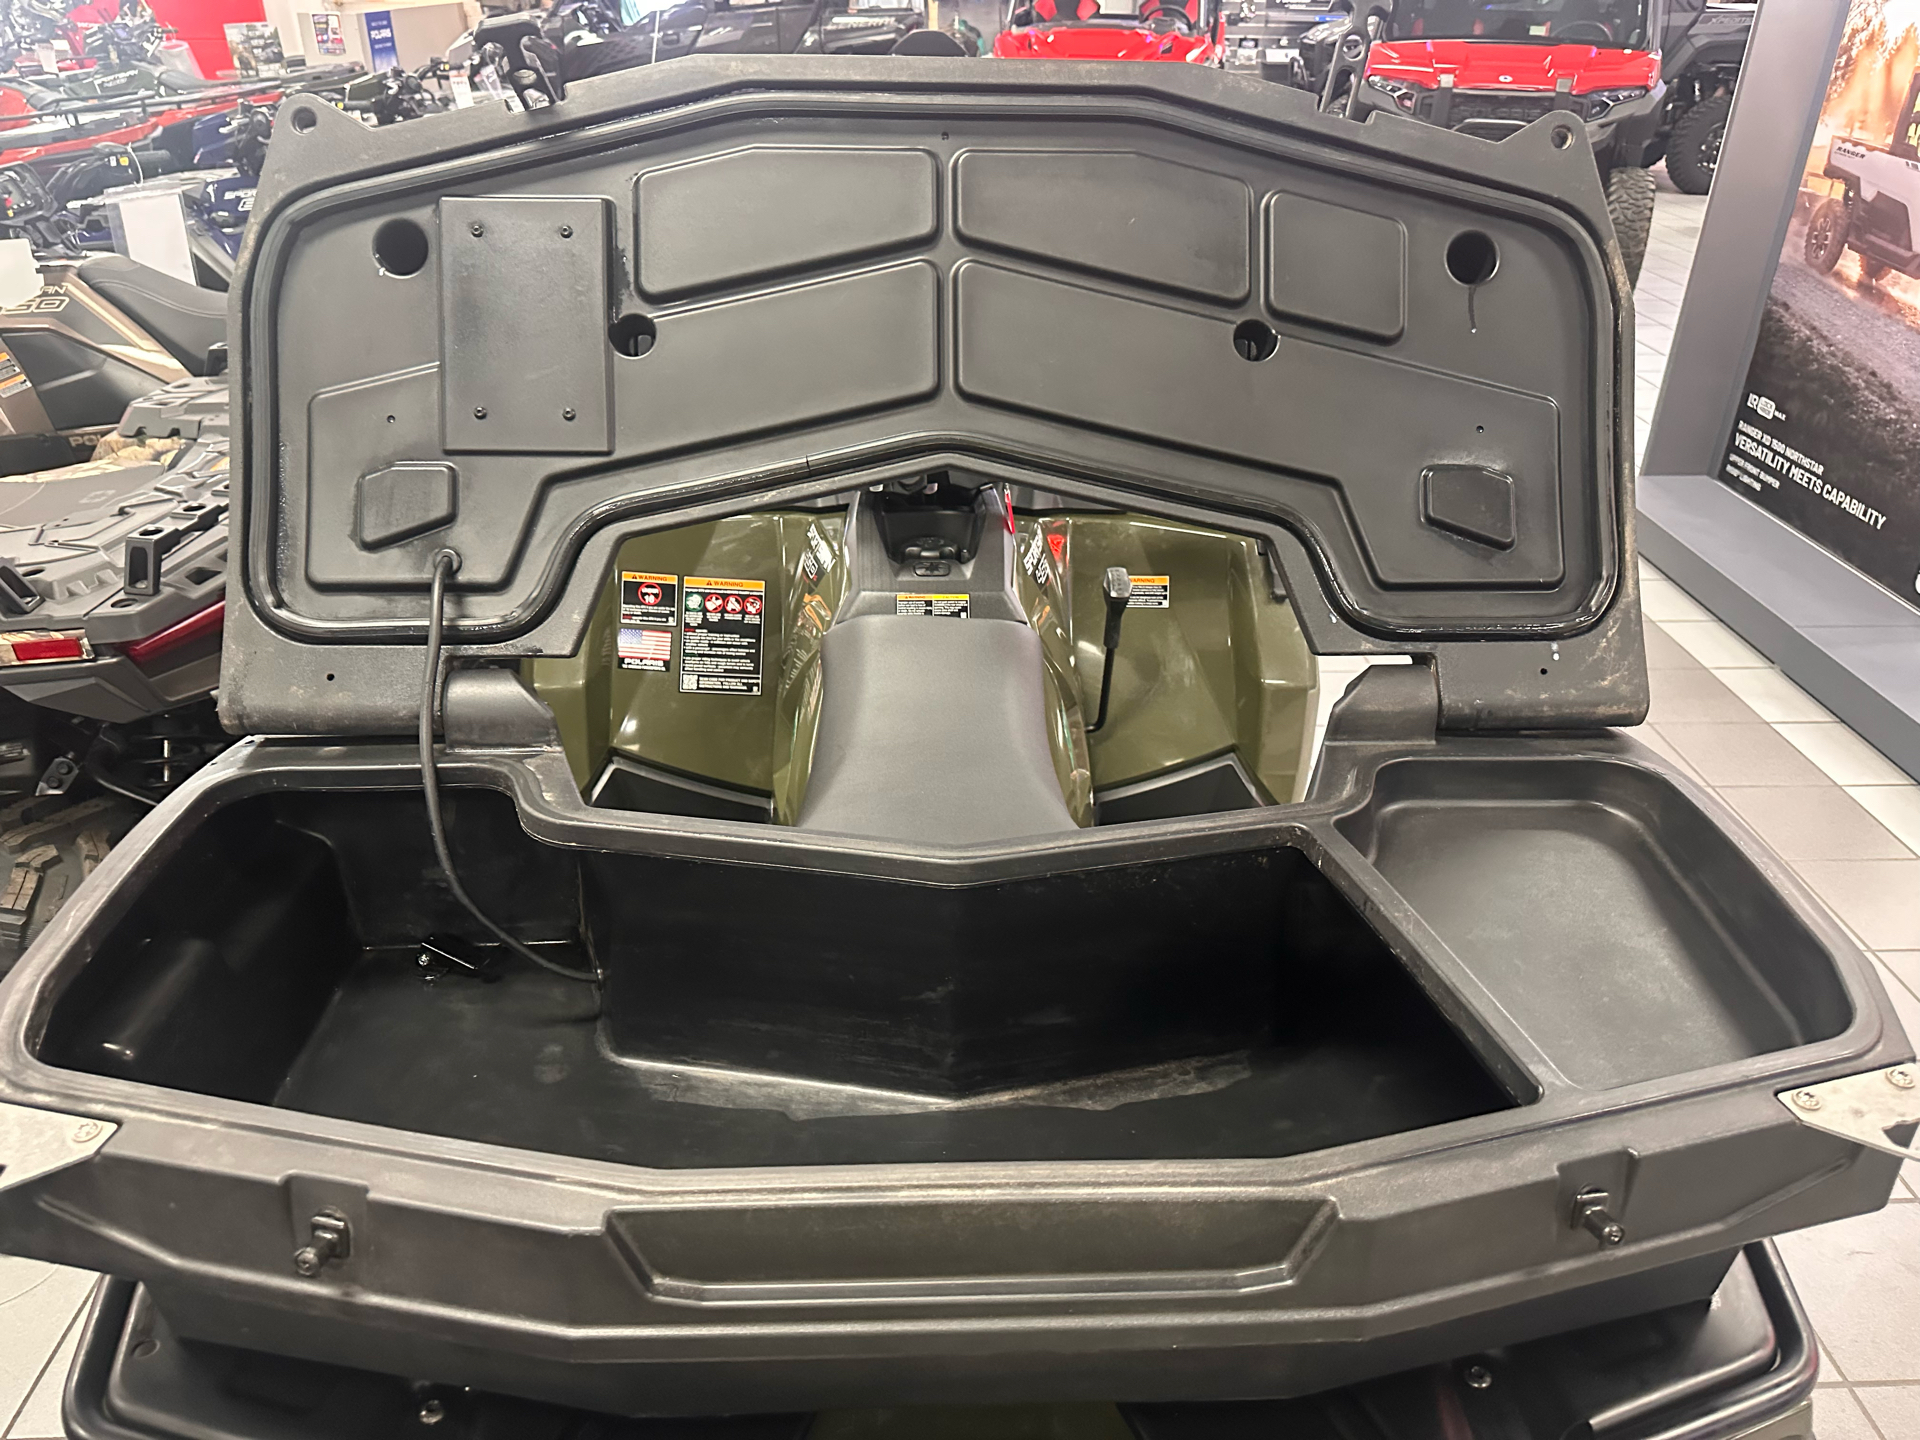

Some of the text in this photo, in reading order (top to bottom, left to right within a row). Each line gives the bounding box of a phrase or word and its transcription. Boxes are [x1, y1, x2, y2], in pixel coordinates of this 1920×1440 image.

[1836, 146, 1866, 160] RANGER
[0, 296, 70, 315] 50
[1784, 445, 1825, 476] NORTHSTAR
[1734, 432, 1791, 475] VERSATILITY
[1789, 464, 1823, 495] MEETS
[1822, 484, 1887, 530] CAPABILITY
[638, 574, 668, 582] WARNING
[713, 580, 744, 588] WARNING
[623, 657, 664, 667] POLARIS
